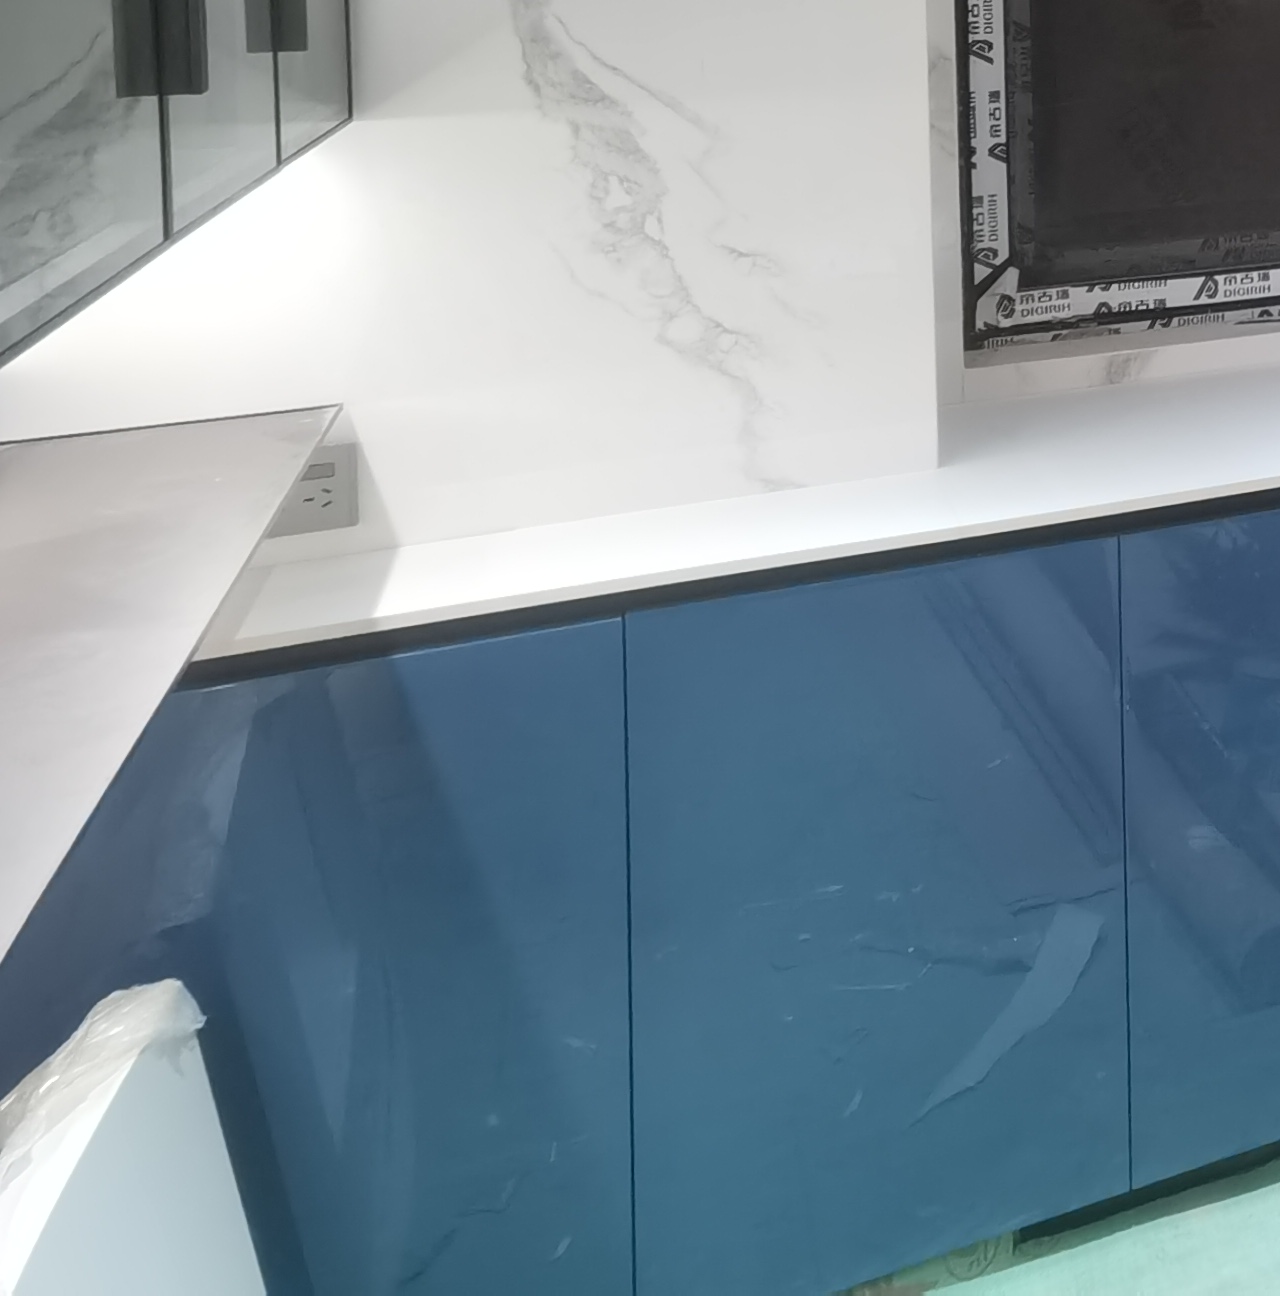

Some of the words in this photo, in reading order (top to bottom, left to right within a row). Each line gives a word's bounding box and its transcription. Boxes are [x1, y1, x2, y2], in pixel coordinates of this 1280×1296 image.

[987, 194, 999, 242] DIGIRIH
[1223, 284, 1272, 298] DIGIRIH
[1020, 302, 1072, 318] DIGIRIH
[1177, 314, 1225, 327] DIGIRIH
